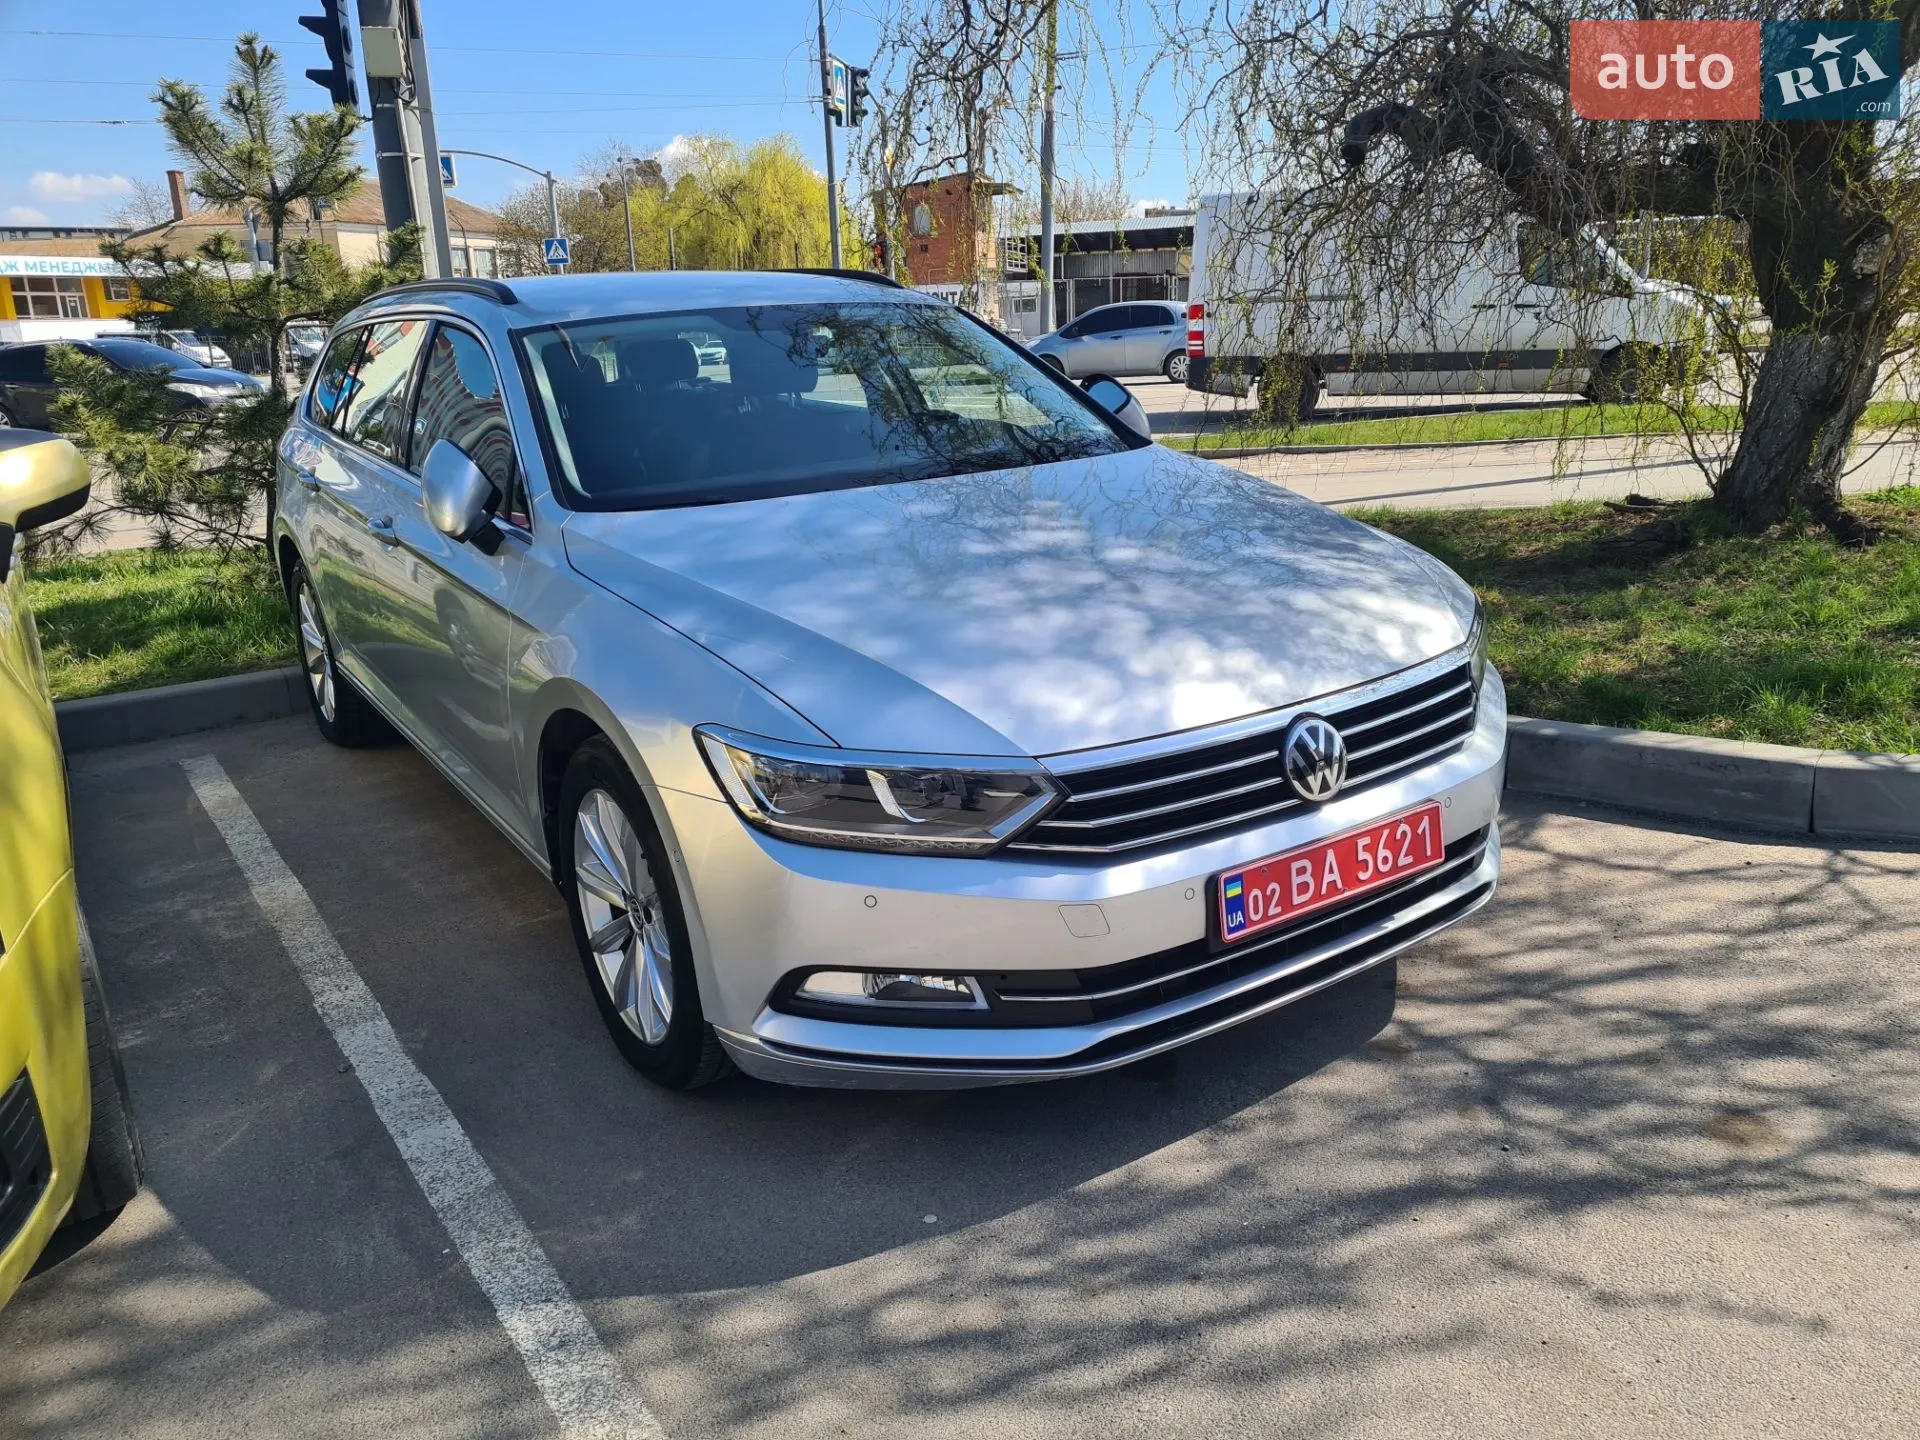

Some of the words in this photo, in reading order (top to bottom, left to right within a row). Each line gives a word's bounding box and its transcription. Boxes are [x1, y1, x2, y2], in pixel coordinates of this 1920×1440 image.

[1248, 882, 1282, 921] 02
[1290, 848, 1343, 905] BA
[1357, 815, 1432, 881] 5621
[1227, 910, 1245, 928] UA
